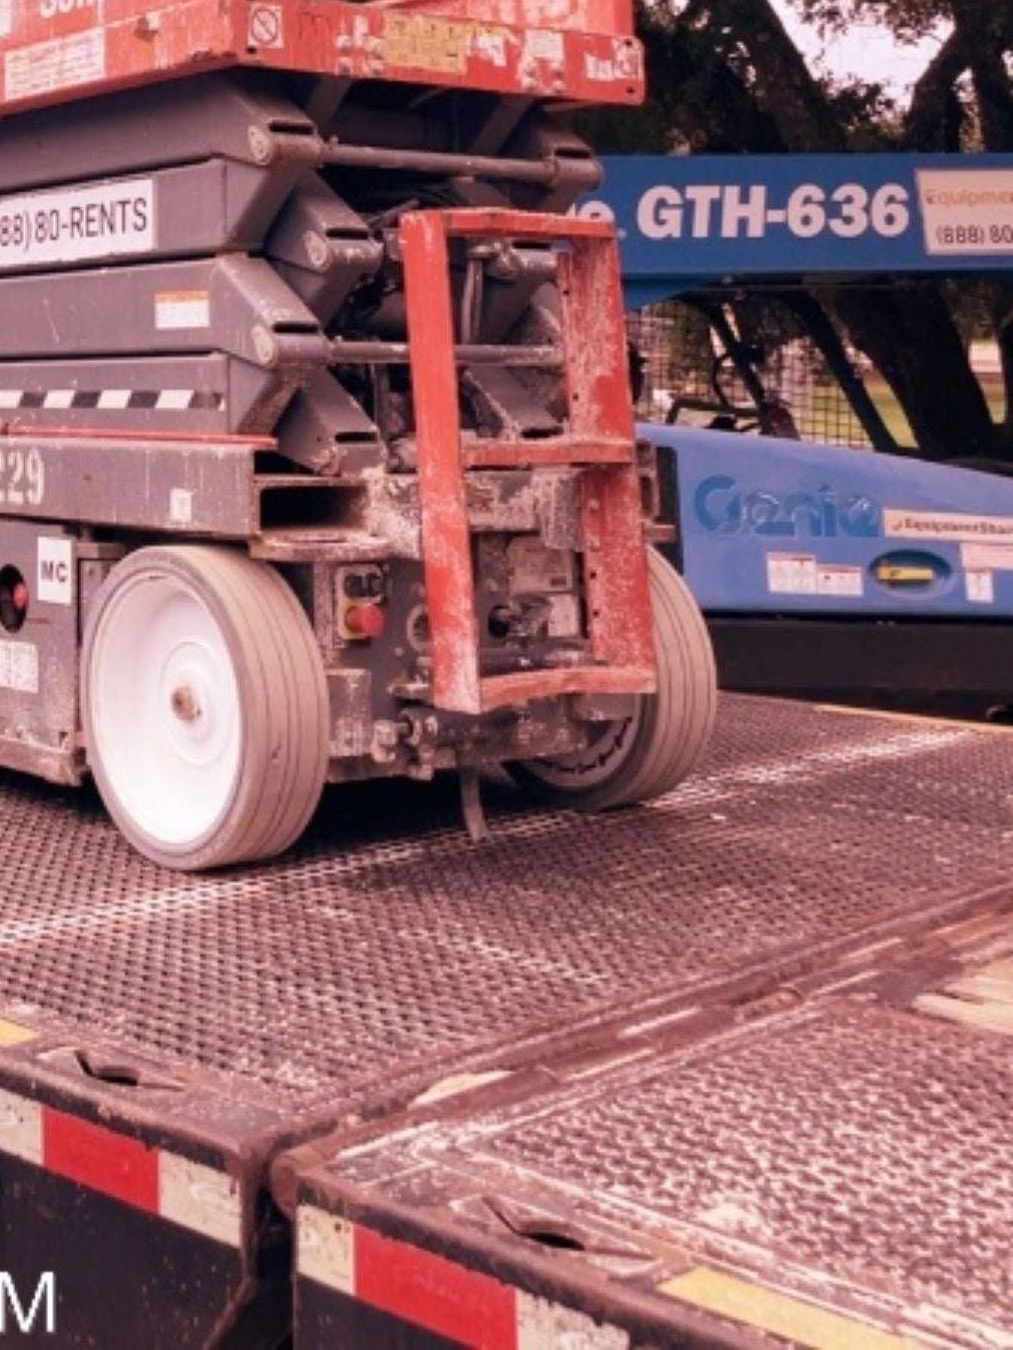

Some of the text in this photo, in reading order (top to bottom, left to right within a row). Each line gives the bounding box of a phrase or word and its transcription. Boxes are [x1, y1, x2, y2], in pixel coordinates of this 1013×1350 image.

[34, 197, 148, 244] 80-RENTS
[636, 182, 910, 239] GTH-636
[935, 223, 985, 247] (888)
[40, 560, 68, 584] MC
